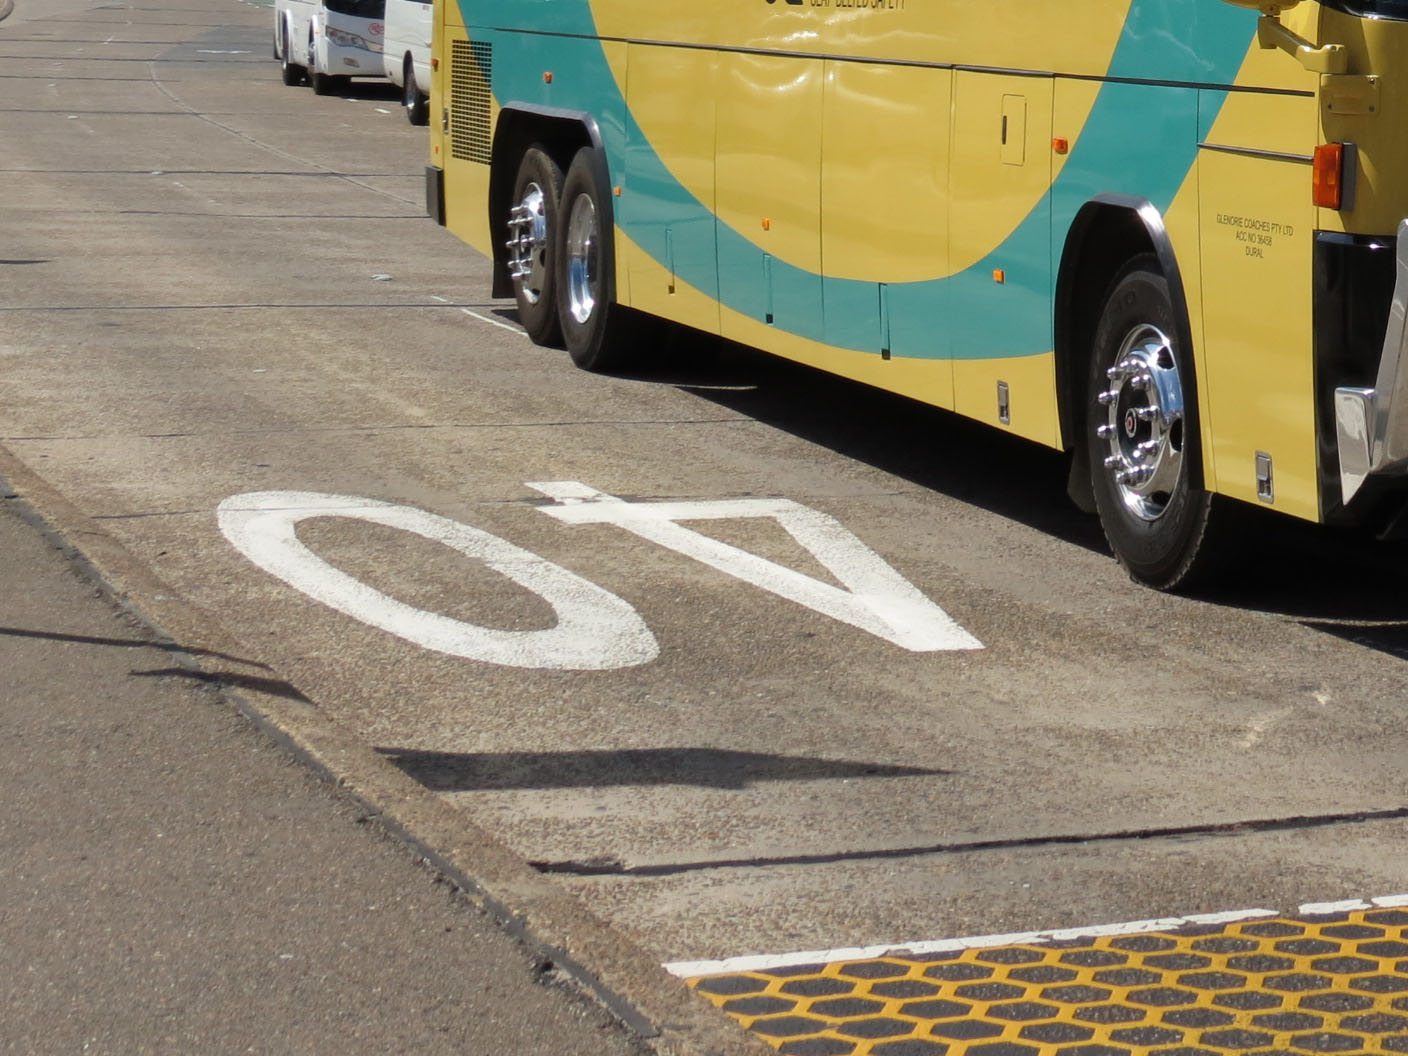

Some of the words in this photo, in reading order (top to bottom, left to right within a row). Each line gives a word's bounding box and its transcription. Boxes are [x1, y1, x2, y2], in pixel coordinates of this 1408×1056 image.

[1244, 218, 1270, 233] COACHES
[1271, 223, 1283, 235] PTY
[1283, 225, 1294, 237] LTD
[1245, 246, 1264, 259] DURAL
